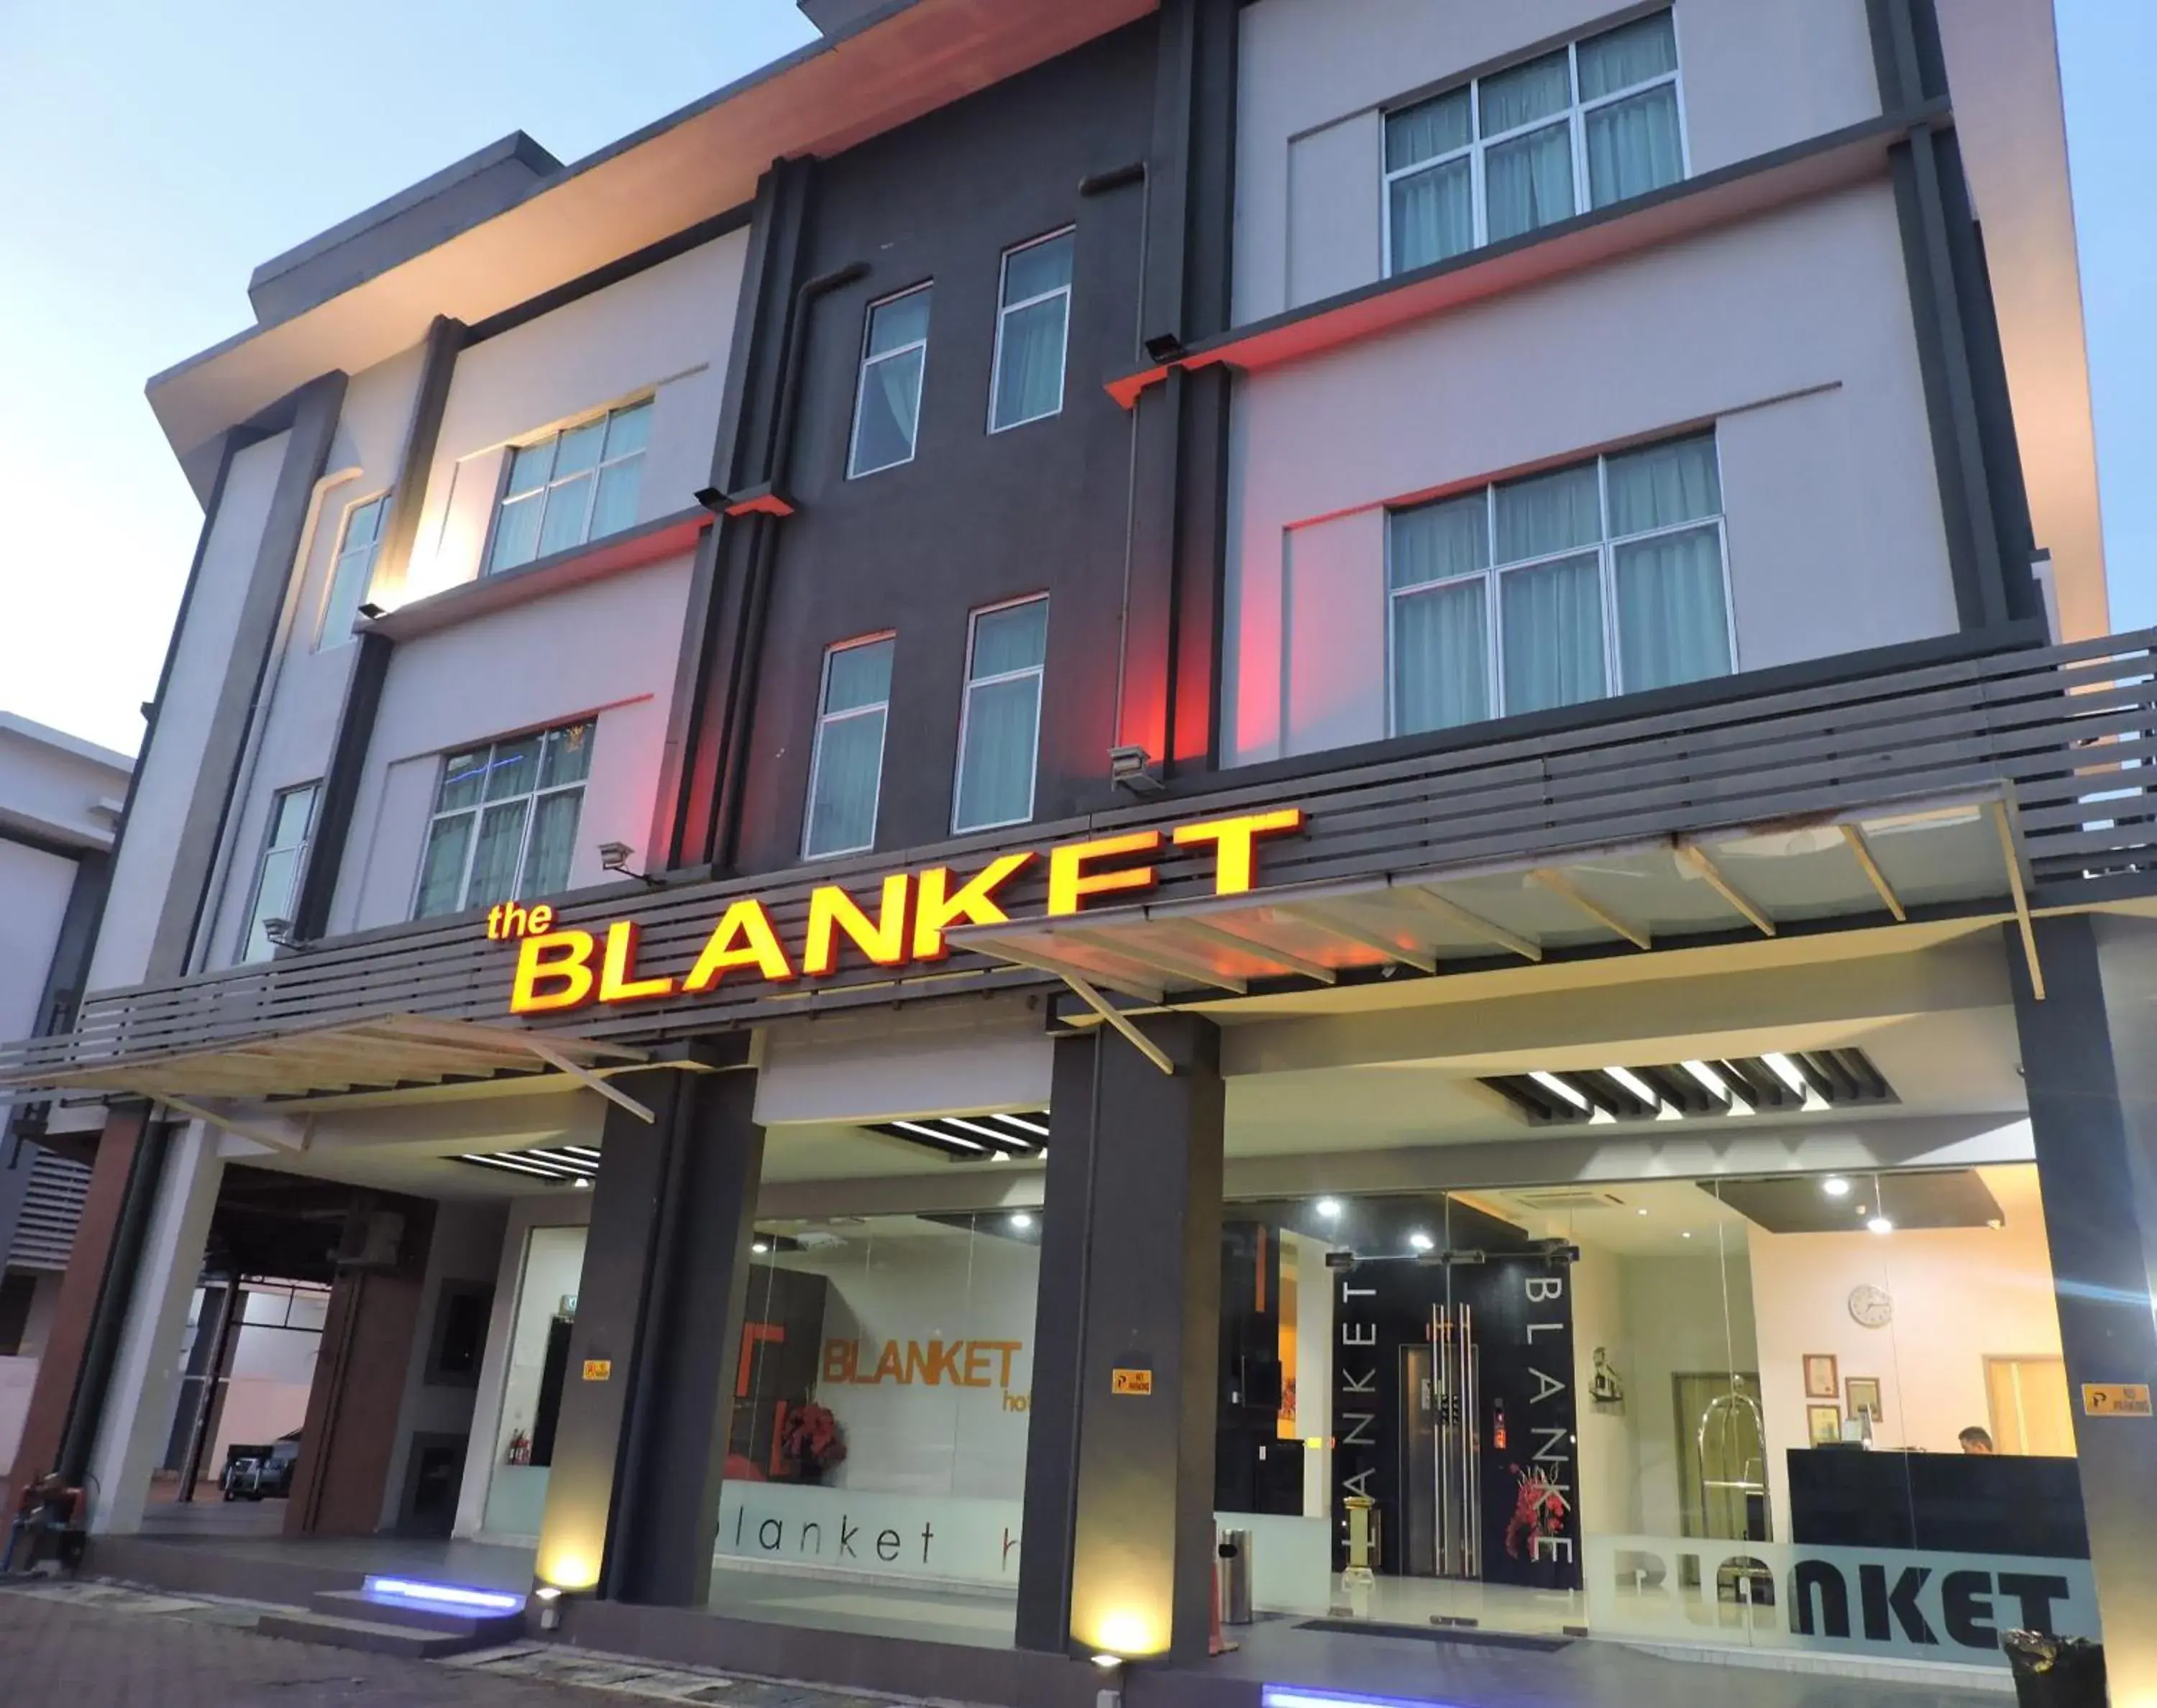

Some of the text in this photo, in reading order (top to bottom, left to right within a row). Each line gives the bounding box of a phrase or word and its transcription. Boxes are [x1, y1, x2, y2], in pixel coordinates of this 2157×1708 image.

[487, 900, 557, 940] the
[823, 1338, 1022, 1387] BLANKET
[716, 1505, 934, 1564] lanket
